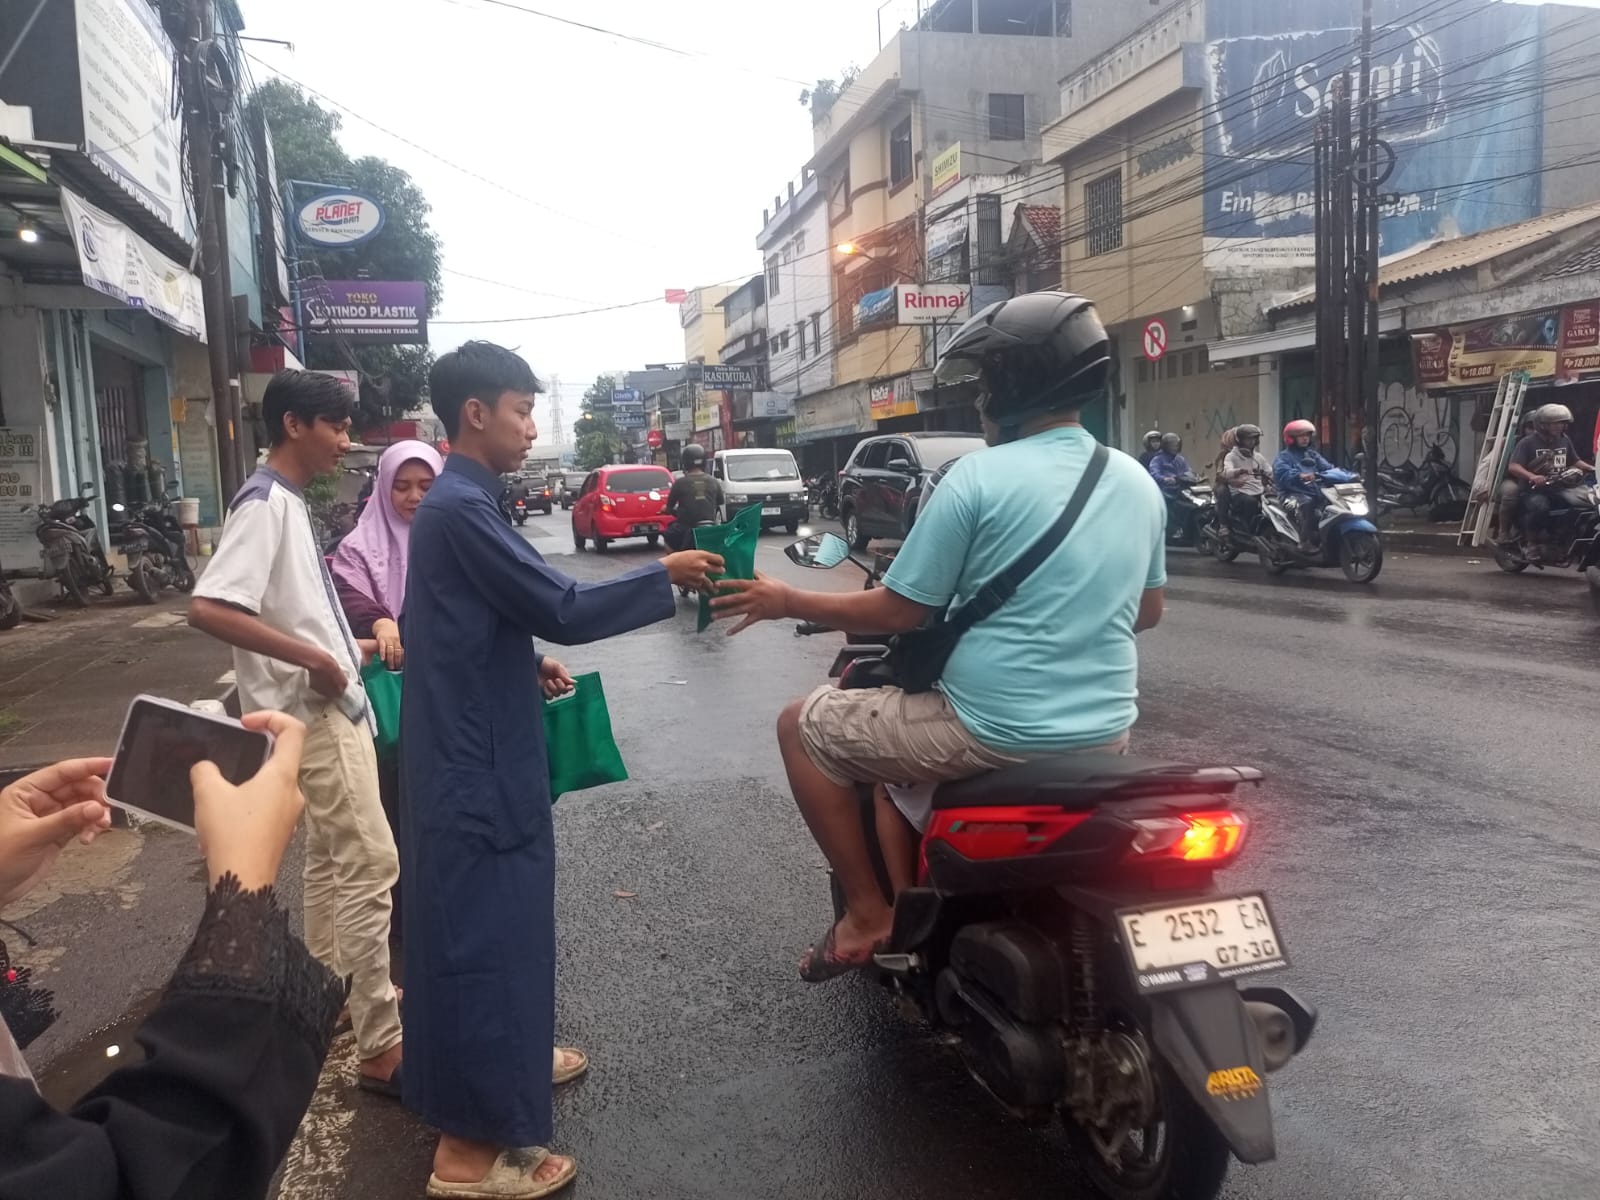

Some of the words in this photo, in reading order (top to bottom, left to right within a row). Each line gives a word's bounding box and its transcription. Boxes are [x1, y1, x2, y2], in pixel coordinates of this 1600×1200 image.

[315, 202, 364, 221] PLANET
[346, 293, 377, 304] TOKO
[904, 291, 965, 308] Rinnai
[370, 305, 417, 318] PLASTIK
[704, 372, 751, 382] KASIMURA
[1128, 919, 1147, 947] E
[1165, 908, 1224, 941] 2532
[1237, 902, 1268, 930] EA
